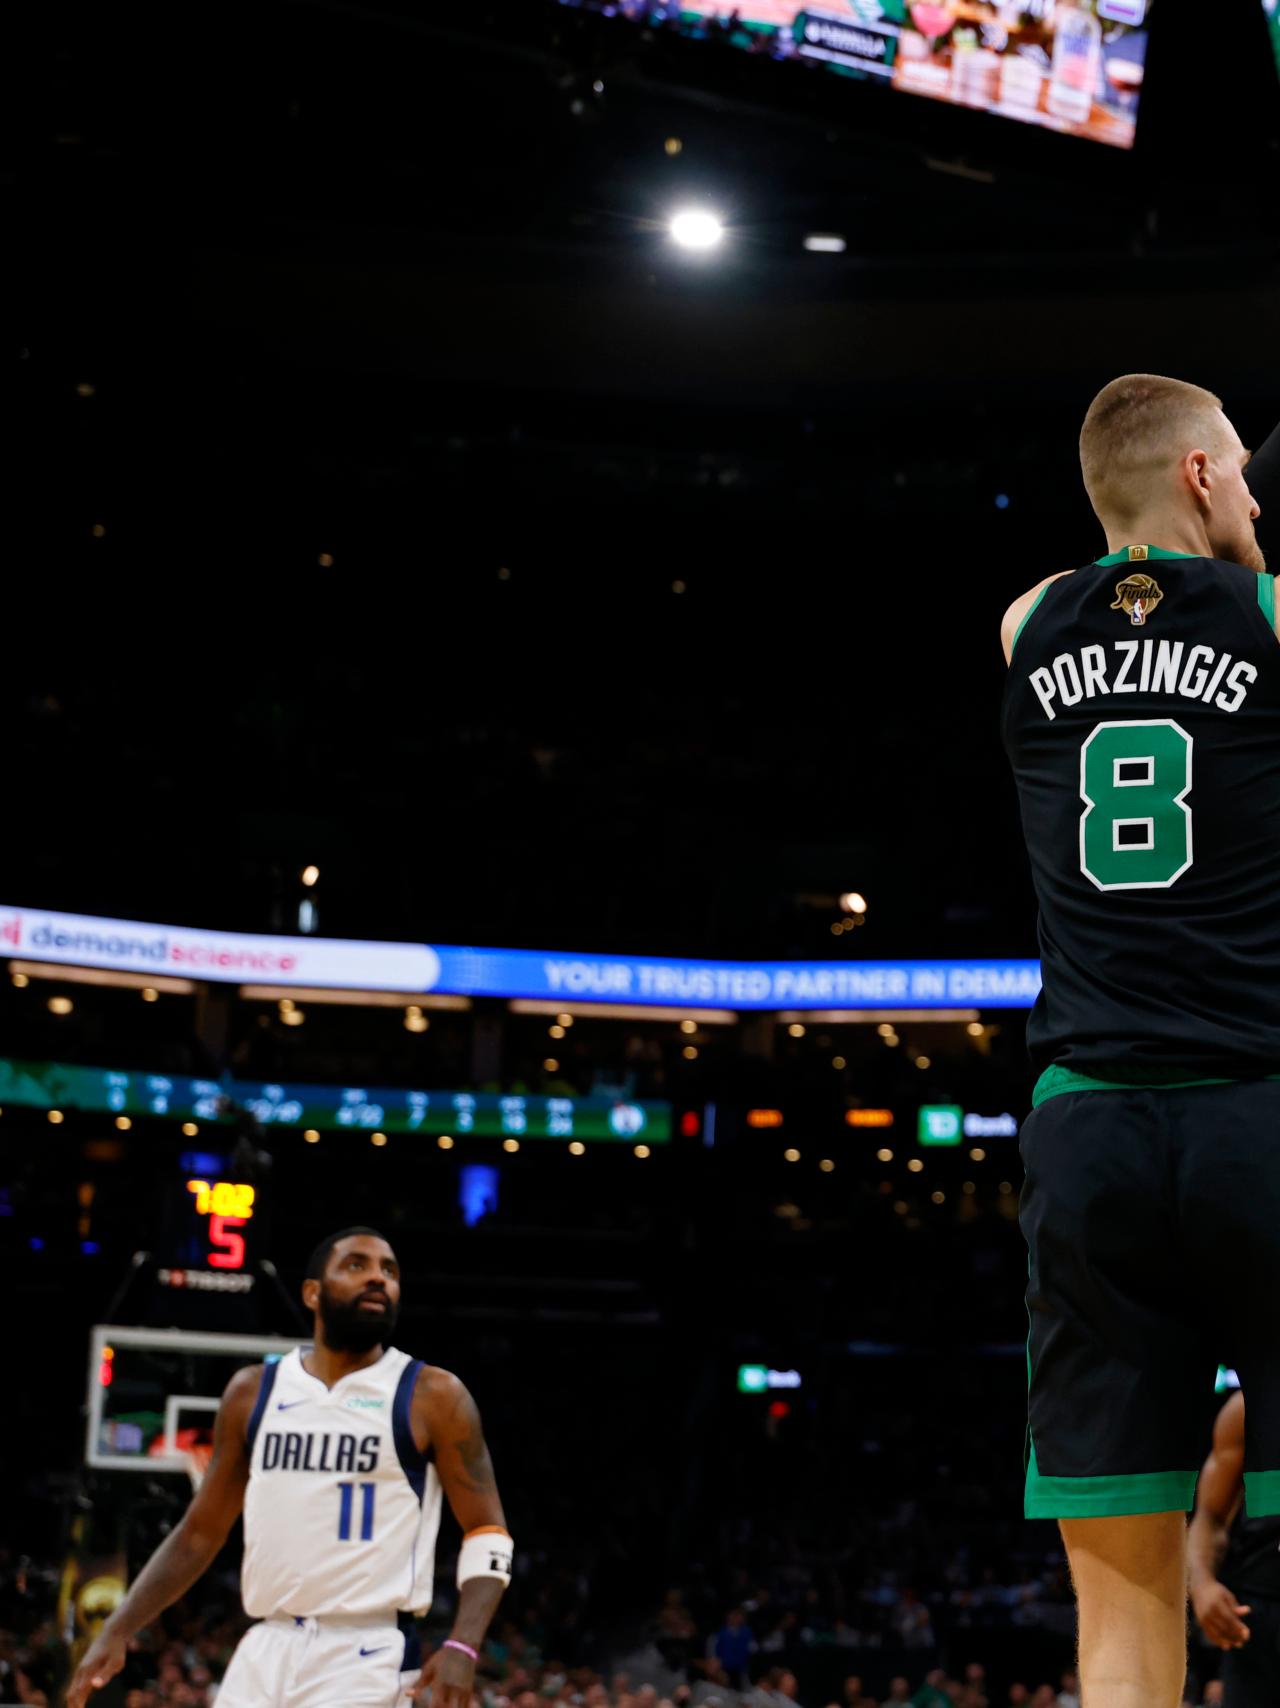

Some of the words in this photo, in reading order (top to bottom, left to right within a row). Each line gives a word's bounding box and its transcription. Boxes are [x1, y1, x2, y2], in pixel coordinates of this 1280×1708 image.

[1028, 639, 1258, 721] PORZINGIS
[1080, 718, 1193, 892] 8
[544, 959, 631, 994] YOUR
[637, 963, 771, 1001] TRUSTED
[774, 968, 908, 1000] PARTNER
[911, 969, 946, 999] IN
[207, 1213, 245, 1269] 5
[262, 1432, 381, 1473] DALLAS
[337, 1482, 376, 1541] 11
